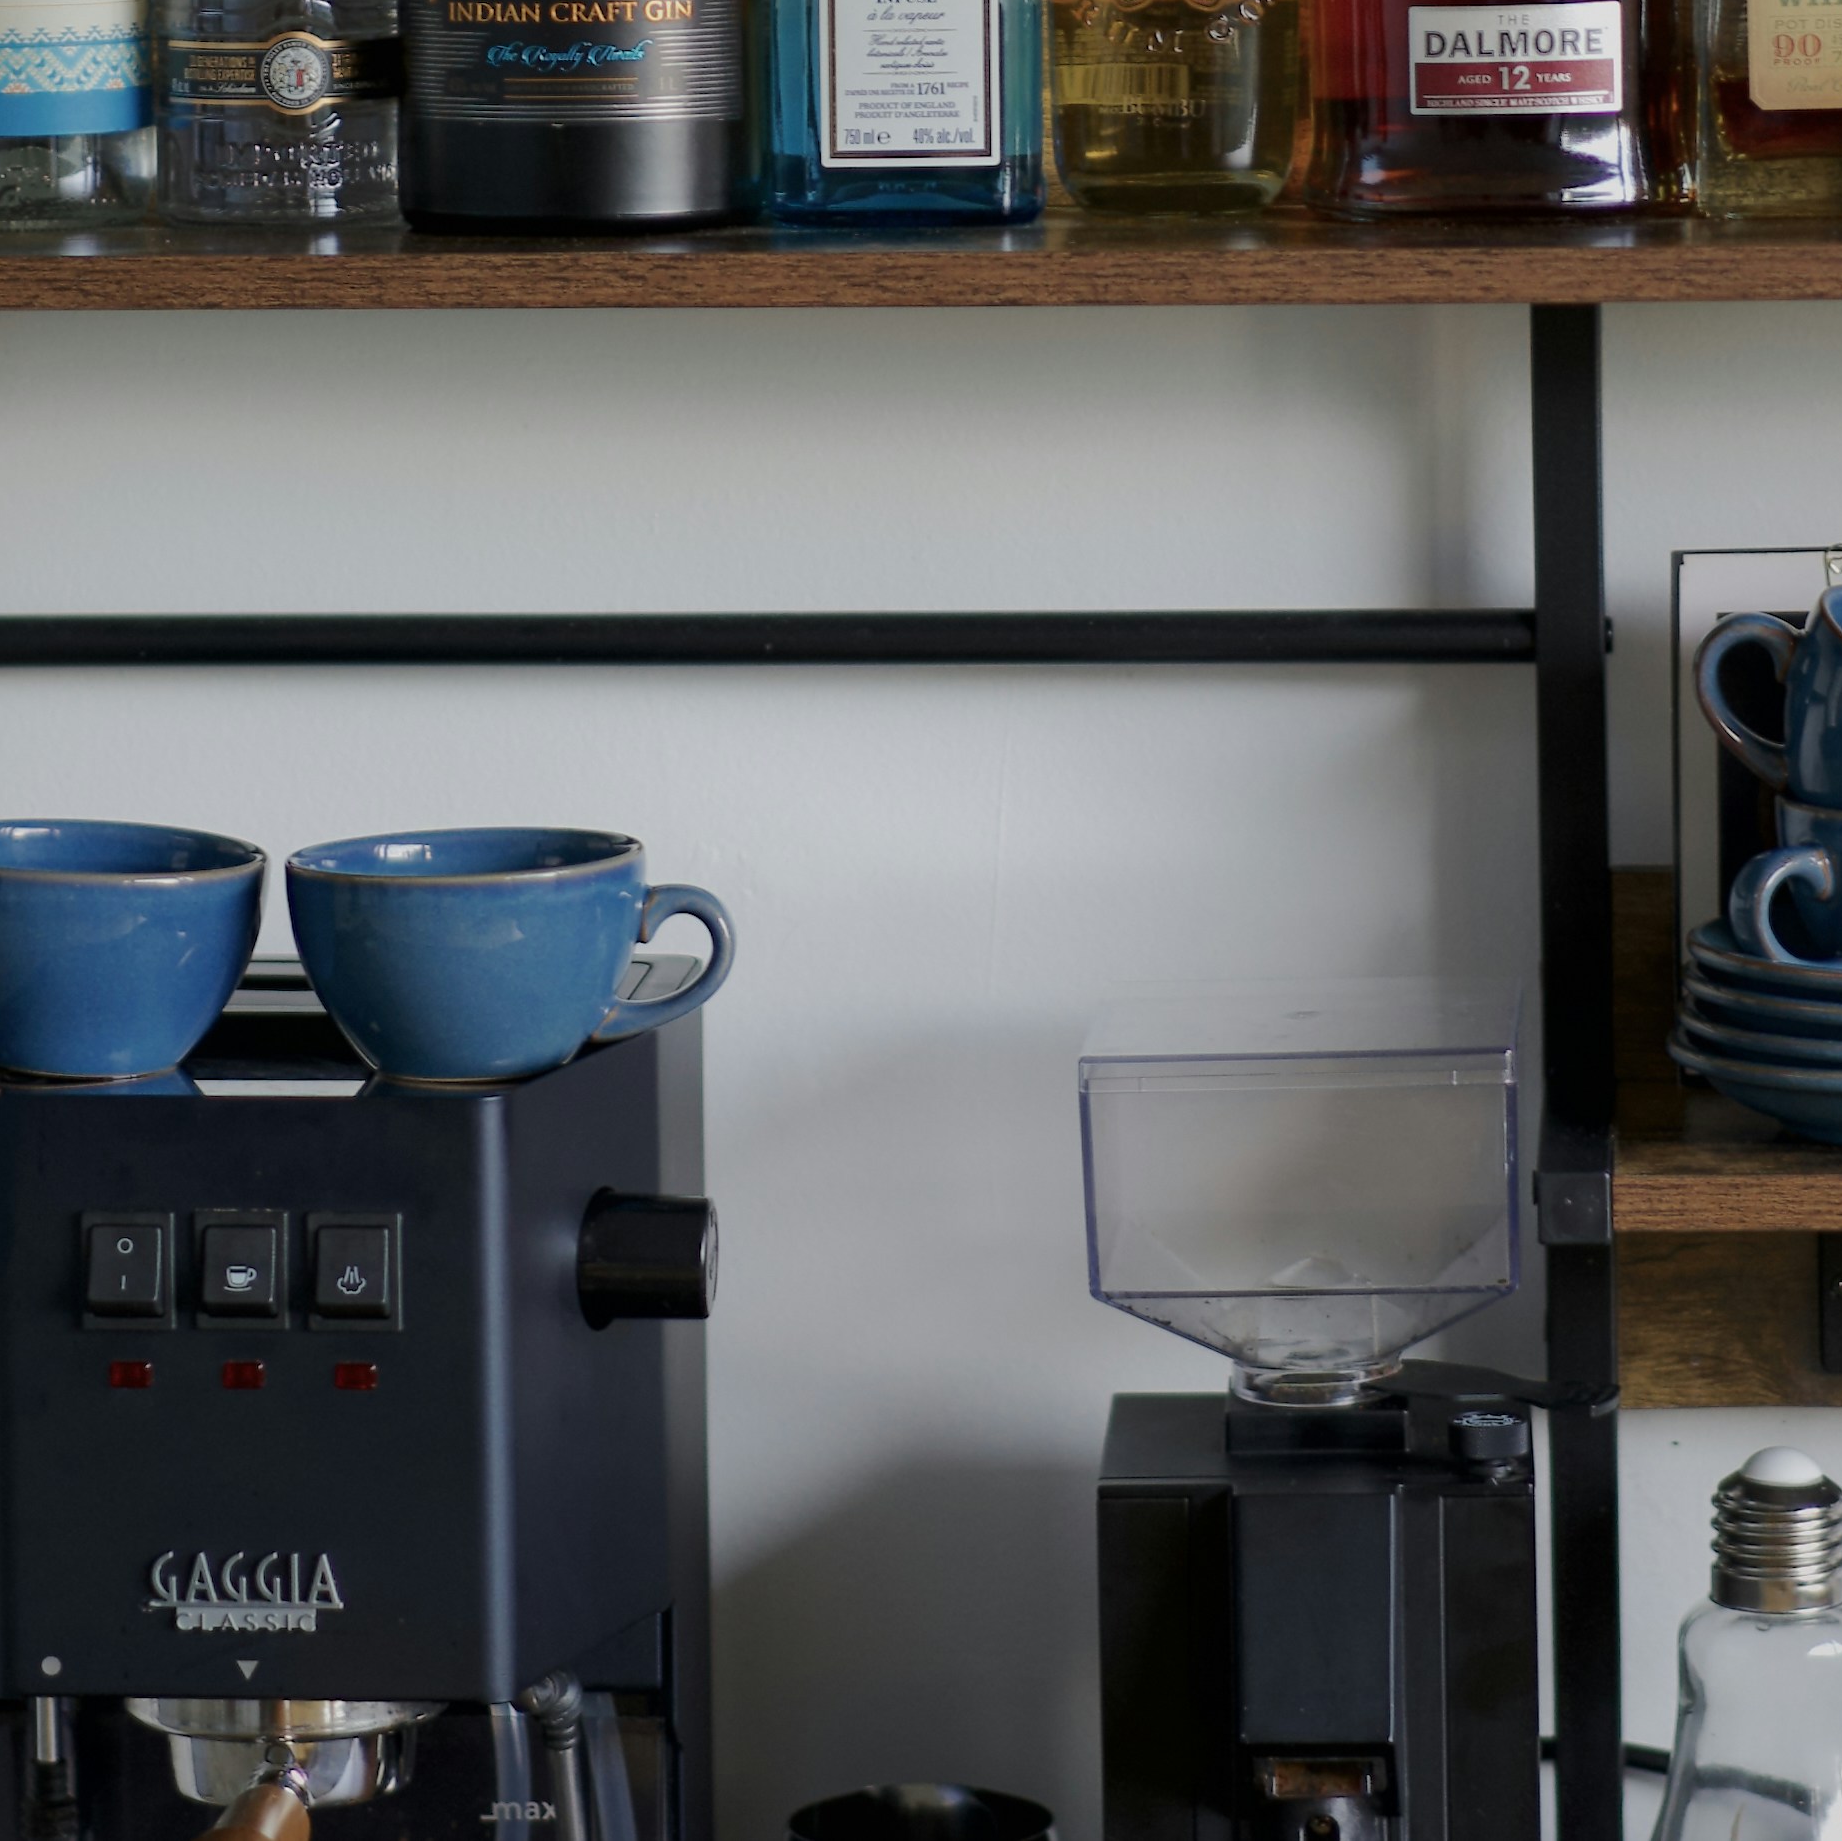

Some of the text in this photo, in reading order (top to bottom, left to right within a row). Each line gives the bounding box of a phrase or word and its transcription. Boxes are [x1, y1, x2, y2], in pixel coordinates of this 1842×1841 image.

[448, 1, 541, 23] INDIAN
[548, 0, 638, 23] CRAFT
[880, 5, 895, 20] la
[898, 12, 946, 24] vapeur
[1497, 14, 1530, 25] THE
[1774, 18, 1809, 30] POT
[1424, 28, 1604, 58] DALMORE
[1771, 33, 1822, 58] 90
[486, 41, 525, 69] The
[1773, 58, 1820, 66] PROOF
[1457, 65, 1572, 91] AGED 12 YEARS
[917, 82, 946, 95] 1761
[854, 111, 892, 119] PRODUIT
[858, 102, 899, 110] PRODUCT
[913, 101, 956, 109] ENGLAND
[844, 128, 860, 145] 750
[150, 1551, 343, 1607] GAGGIA
[176, 1612, 317, 1632] CLASSIC
[491, 1800, 558, 1820] max
